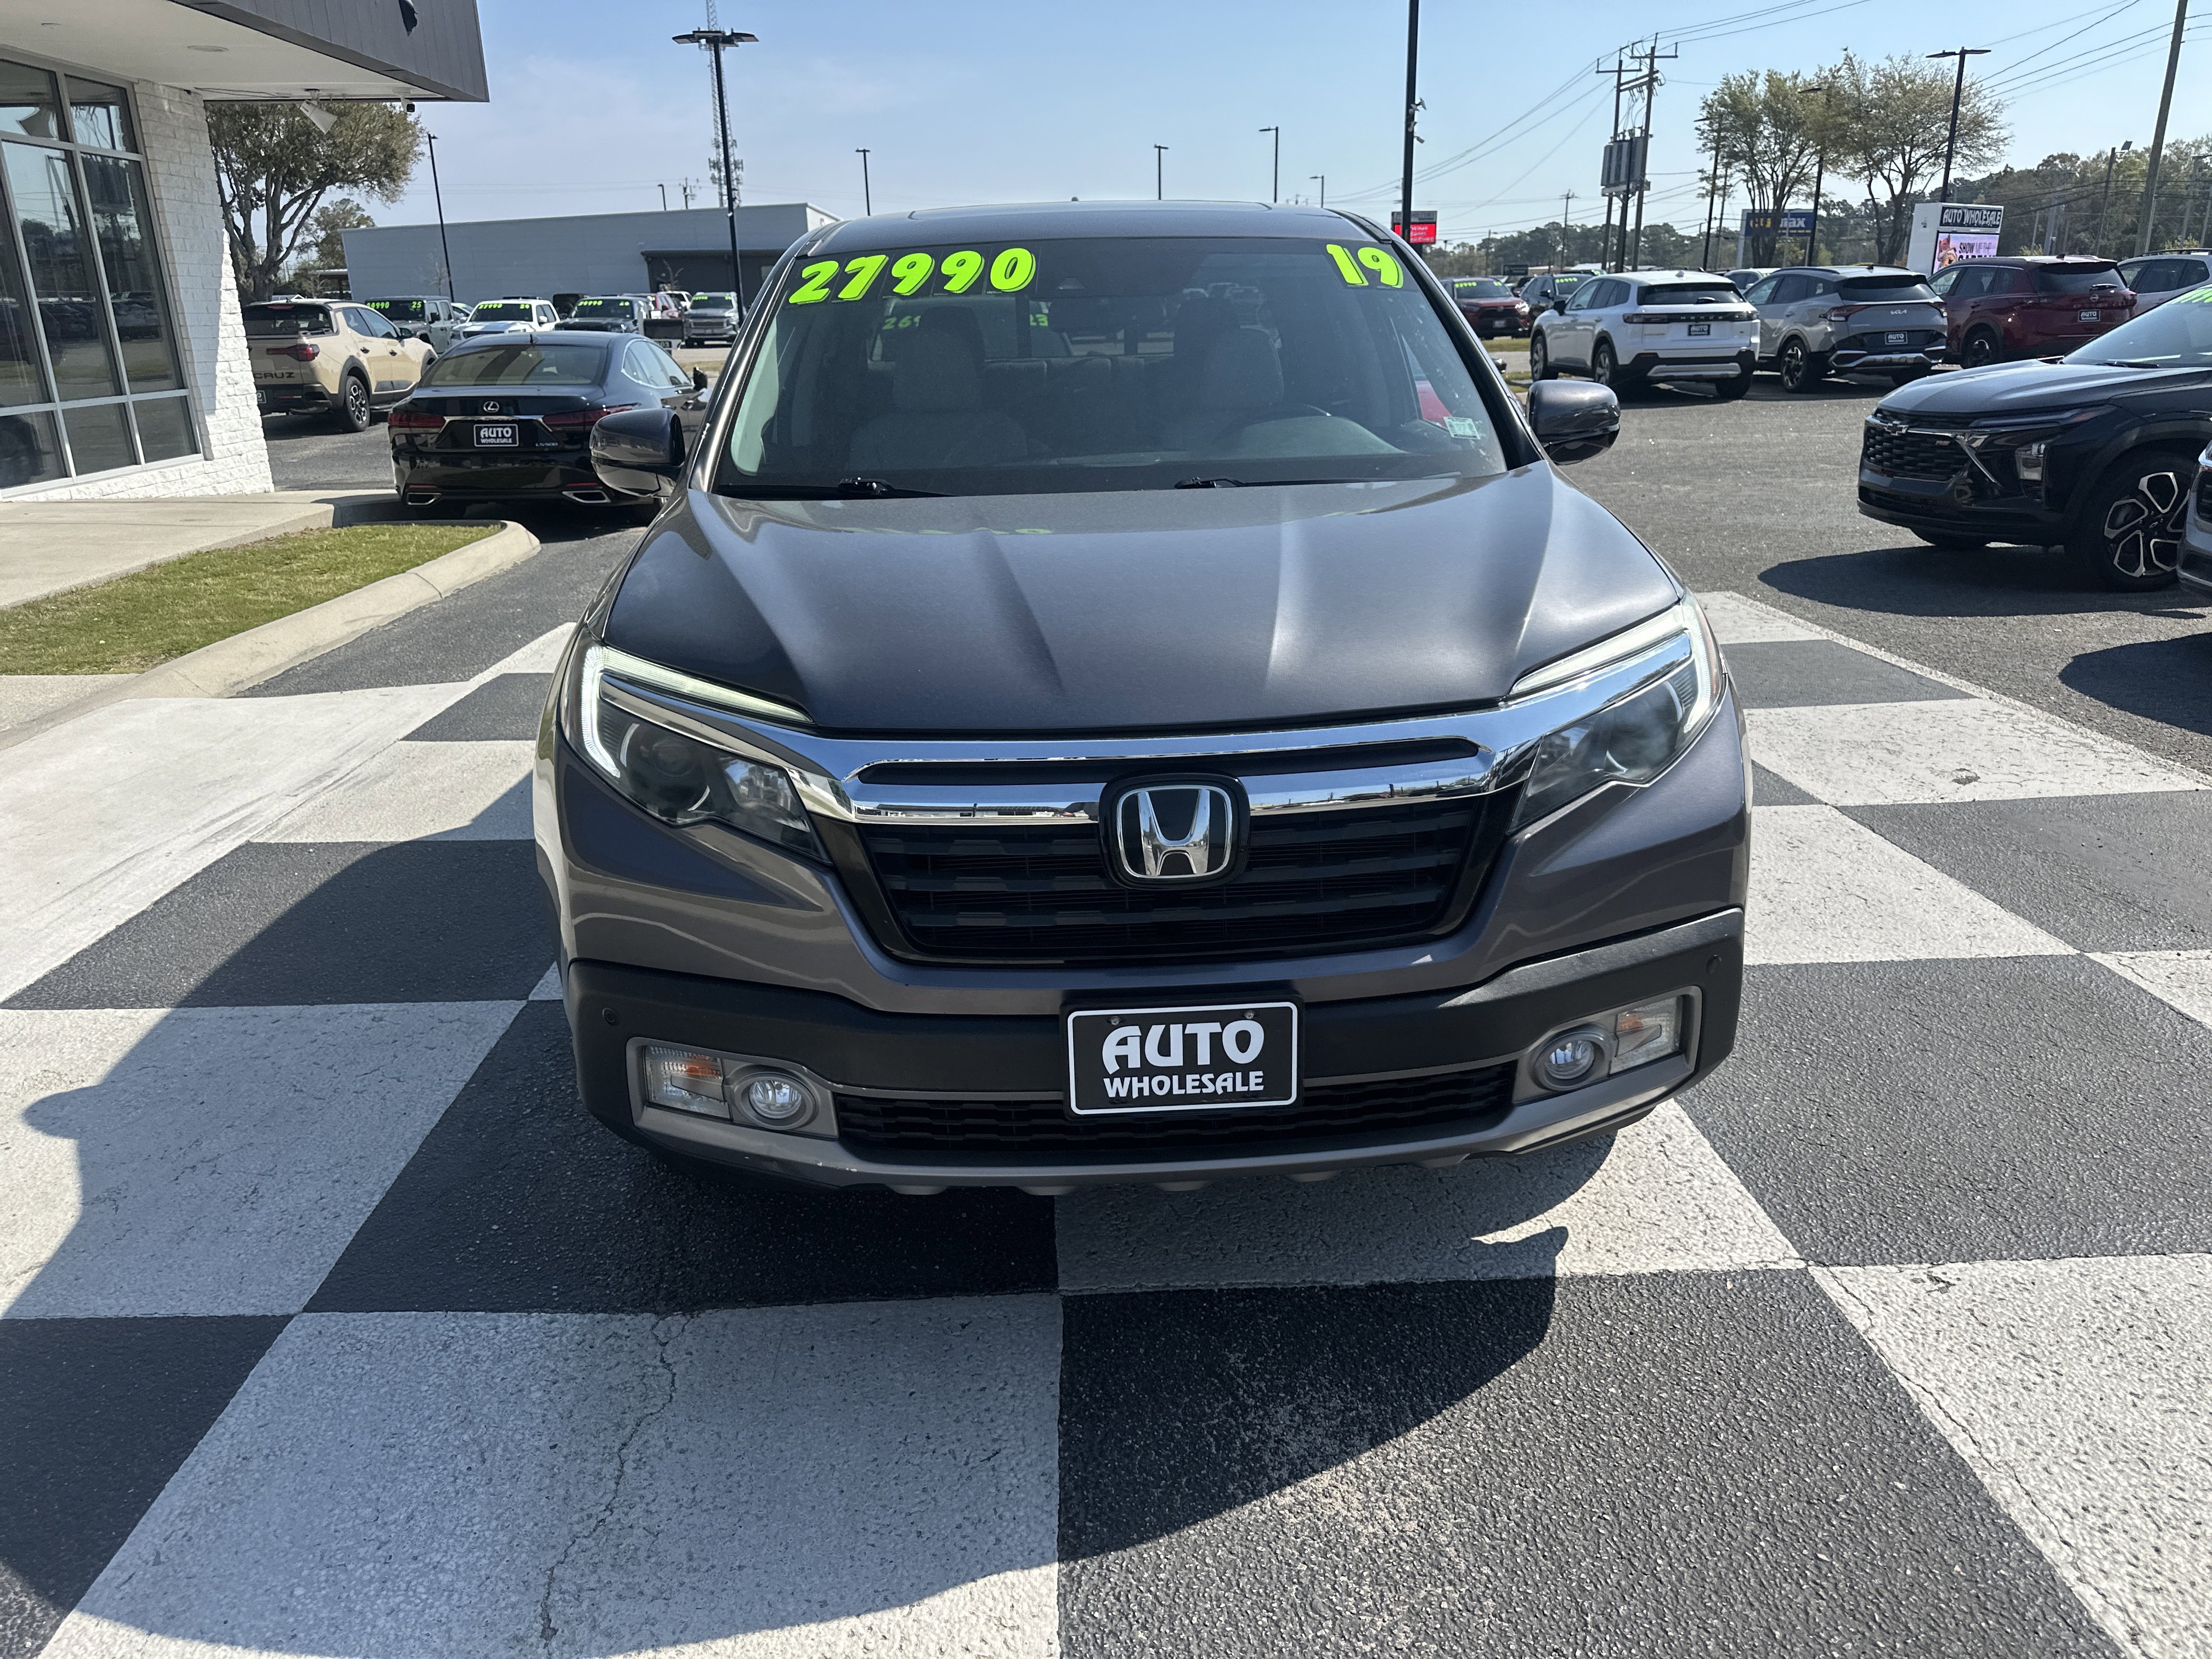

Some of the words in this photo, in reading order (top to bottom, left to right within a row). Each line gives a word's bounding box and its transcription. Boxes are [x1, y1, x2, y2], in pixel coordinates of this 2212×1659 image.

[1943, 209, 1962, 224] AUTO
[1963, 210, 2001, 225] WHOLESALE
[1959, 242, 1975, 253] SHOW
[788, 247, 1036, 304] 27990
[1326, 244, 1403, 288] 19
[480, 427, 512, 438] AUTO
[1102, 1020, 1264, 1074] AUTO
[1103, 1070, 1264, 1098] WHOLESALE
